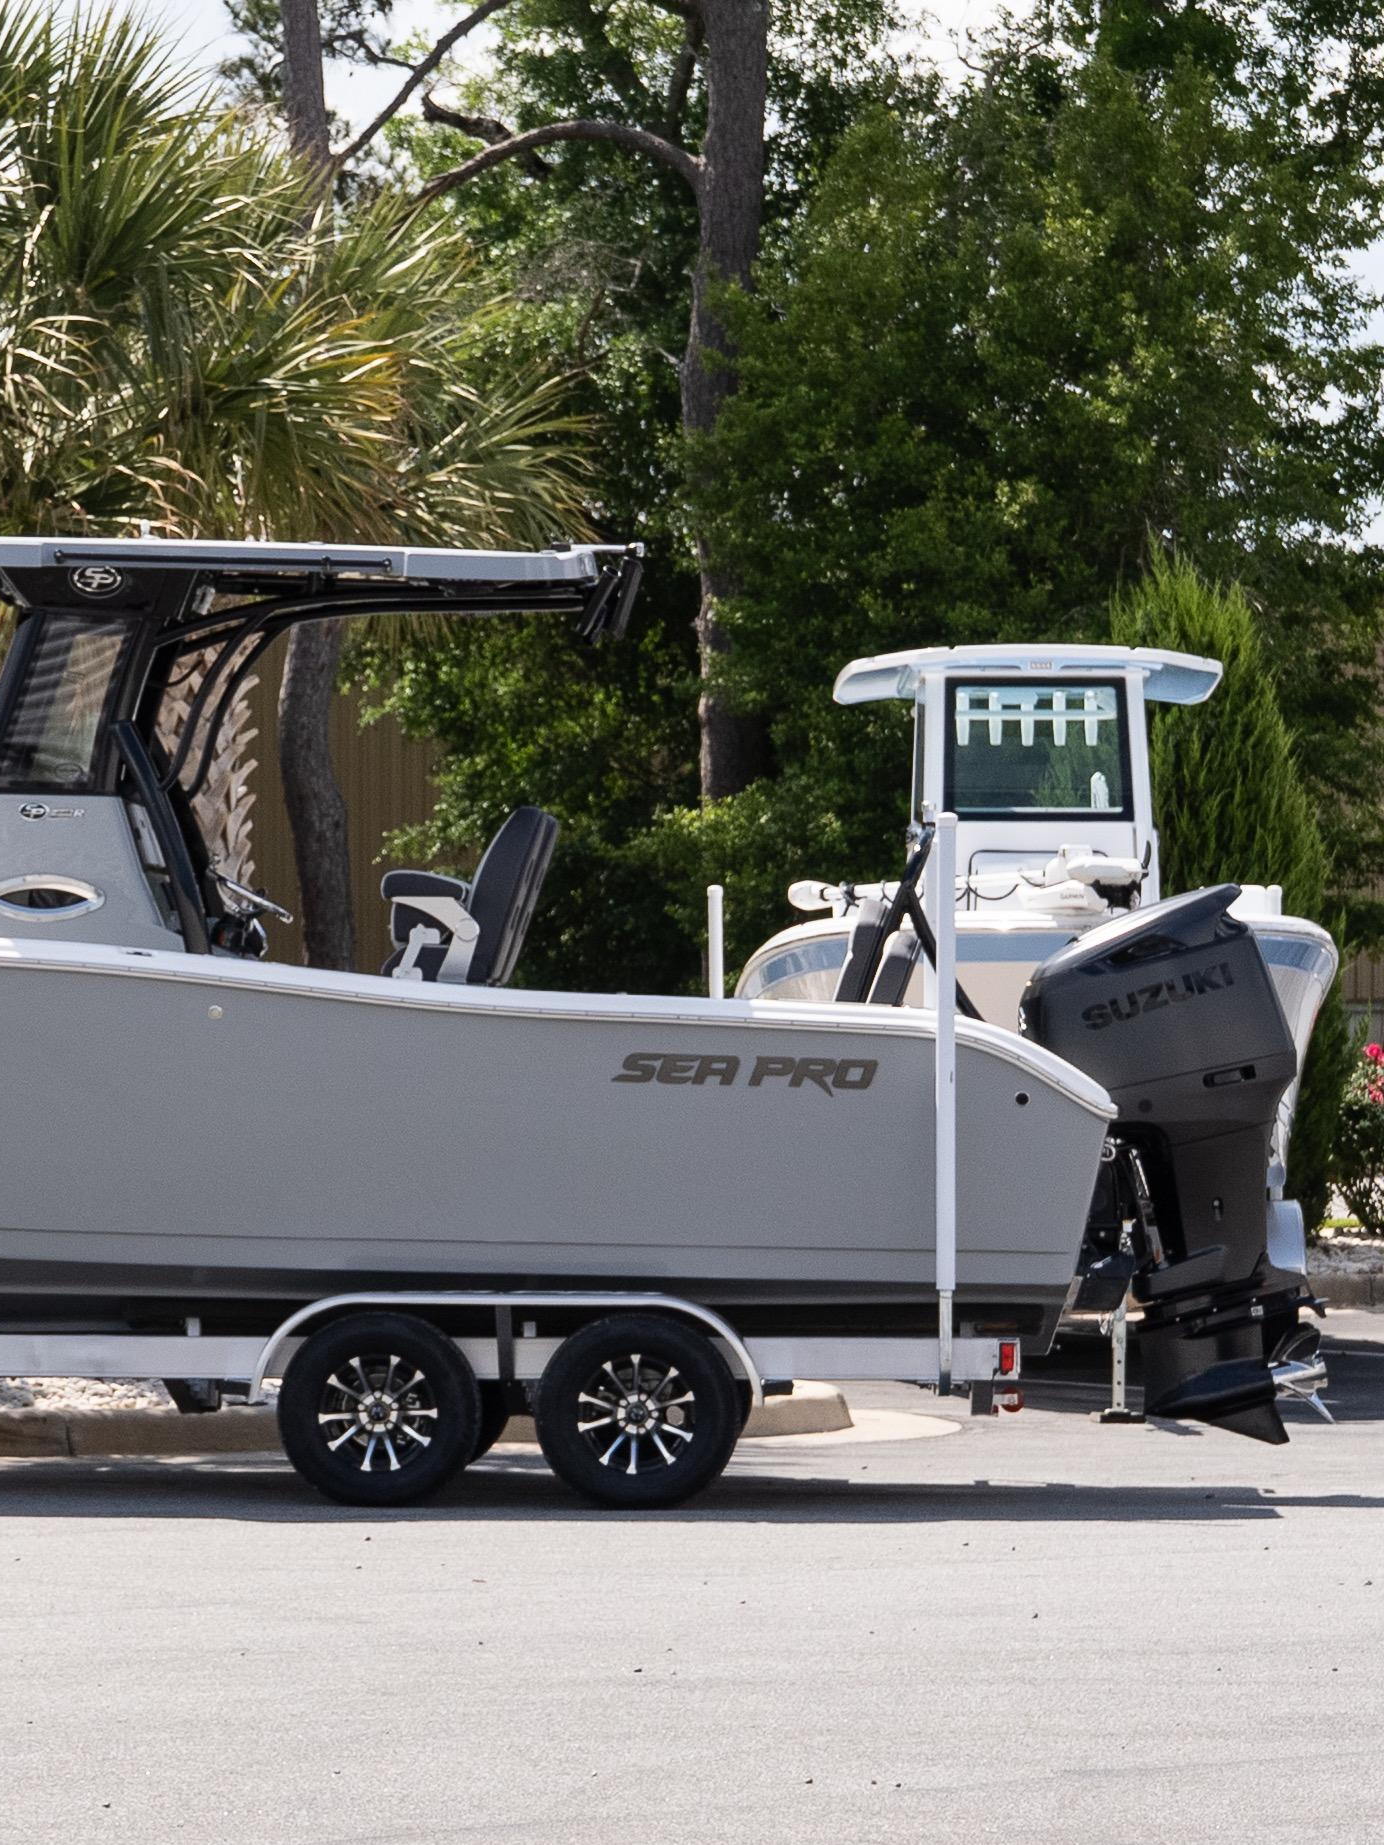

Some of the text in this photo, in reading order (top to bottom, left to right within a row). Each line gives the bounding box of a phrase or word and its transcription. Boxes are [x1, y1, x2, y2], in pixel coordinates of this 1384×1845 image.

[1081, 962, 1235, 1031] SUZUKI
[611, 1052, 879, 1098] SEA PRO
